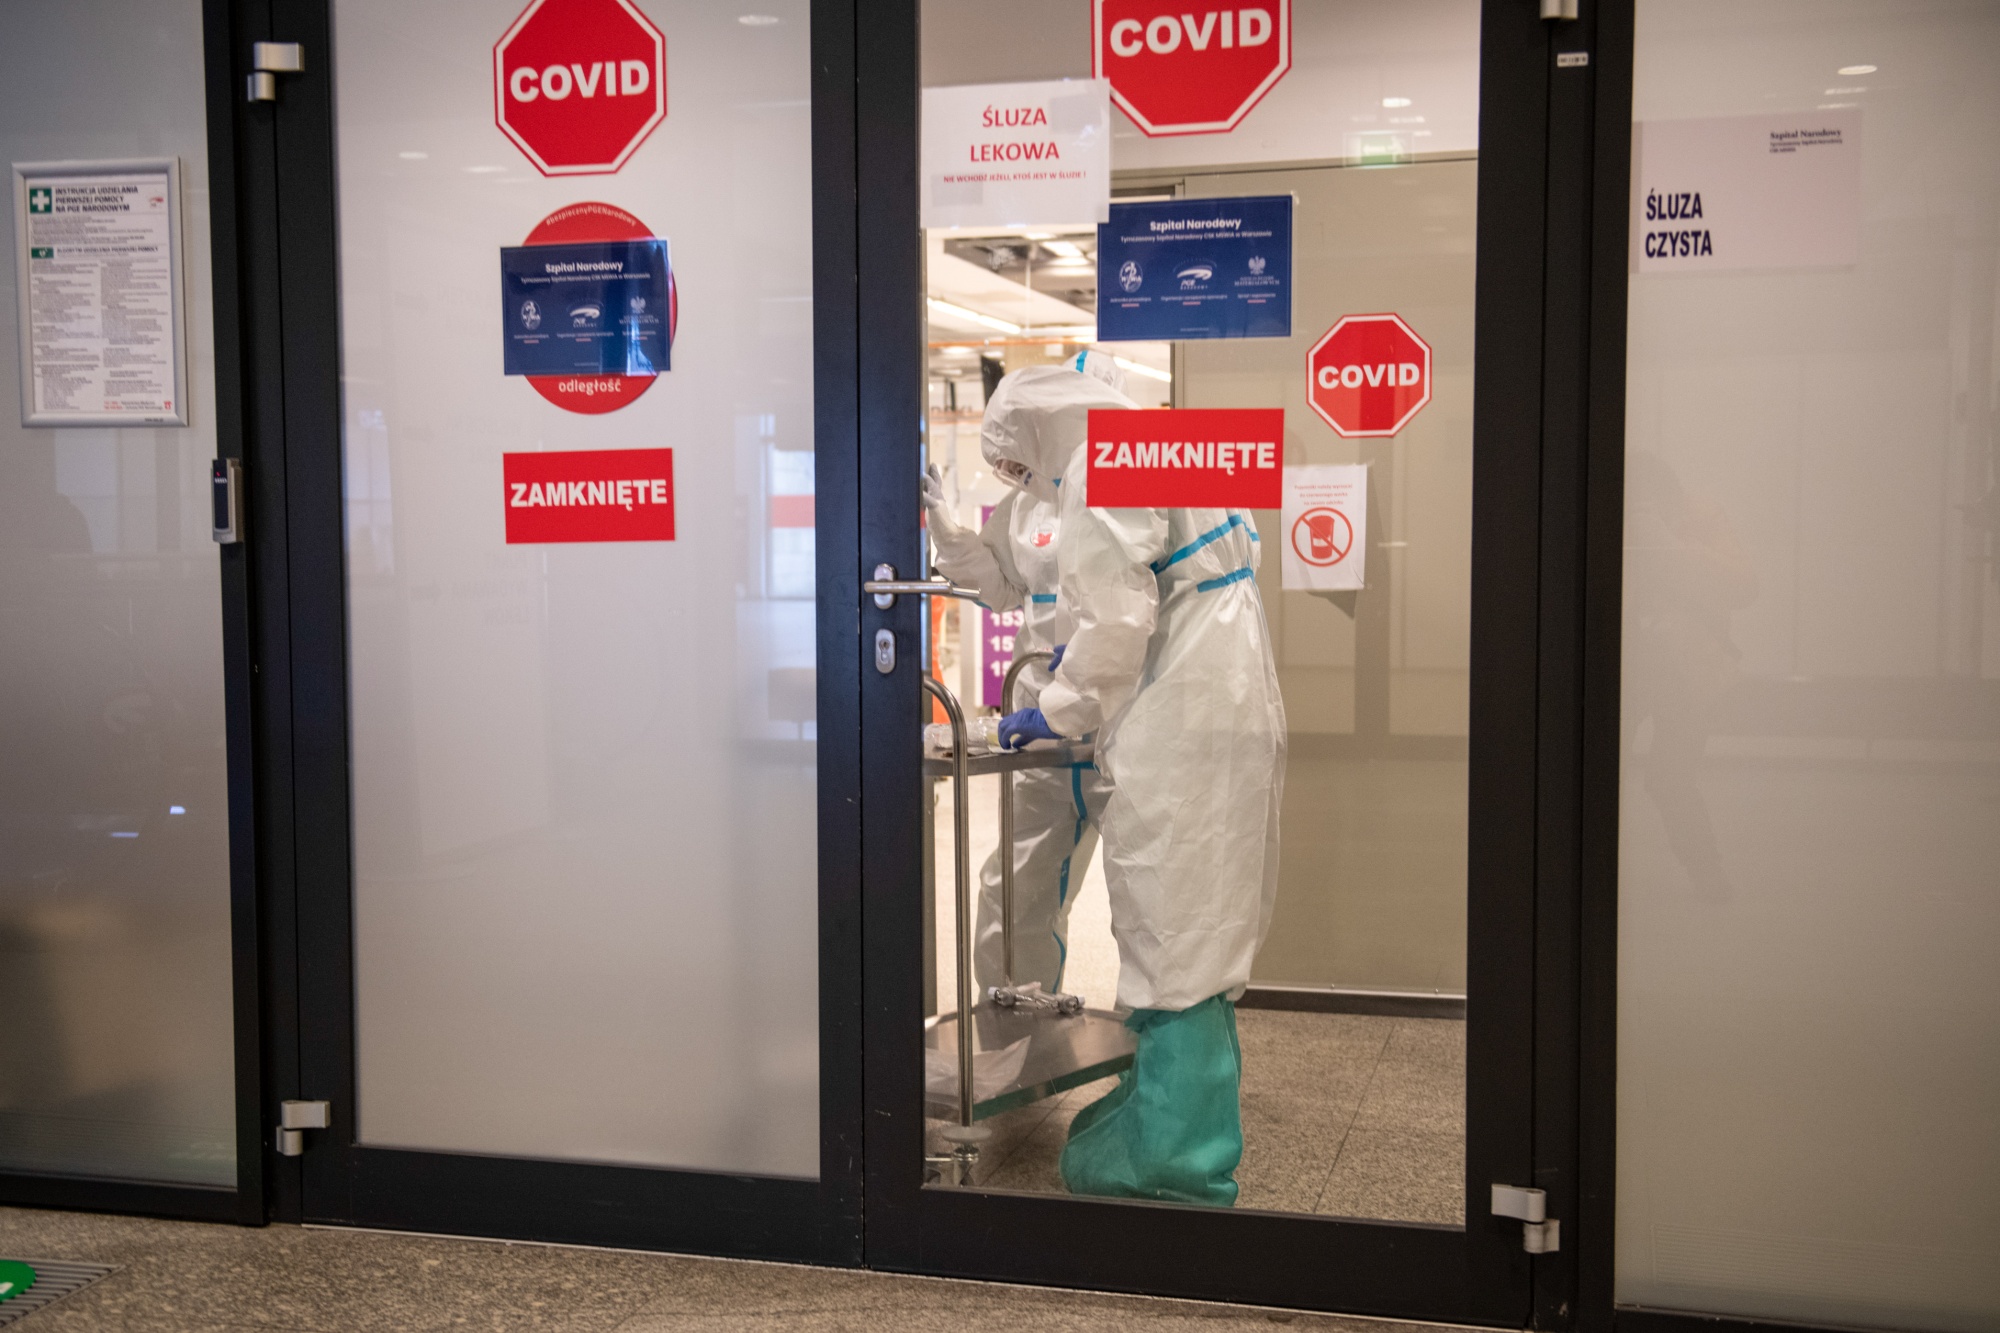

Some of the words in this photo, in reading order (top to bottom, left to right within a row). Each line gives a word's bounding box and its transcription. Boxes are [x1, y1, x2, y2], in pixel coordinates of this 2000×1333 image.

[1110, 8, 1272, 57] COVID
[510, 59, 650, 103] COVID
[982, 104, 1047, 128] ŚLUZA
[1800, 128, 1842, 139] Narodowy
[970, 142, 1060, 162] LEKOWA
[943, 174, 955, 183] NIE
[1013, 171, 1031, 181] KTOŚ
[1033, 172, 1047, 180] JEST
[1059, 170, 1082, 180] ŚLUZIE
[55, 187, 96, 195] INSTRUKCJA
[97, 186, 138, 194] UDZIELANIA
[55, 196, 93, 204] PIERWSZEJ
[55, 205, 66, 213] NA
[82, 204, 130, 212] NARODOWYM
[1646, 187, 1703, 221] ŚLUZA
[1150, 219, 1185, 233] Szpital
[1186, 217, 1242, 230] Narodowy
[1645, 230, 1713, 258] CZYSTA
[545, 262, 575, 275] Szpital
[576, 260, 623, 273] Narodowy
[1317, 362, 1420, 390] COVID
[558, 378, 622, 396] odległość
[1093, 441, 1276, 476] ZAMKNIĘTE
[510, 479, 668, 511] ZAMKNIĘTE
[990, 611, 1025, 628] 153
[990, 635, 1015, 652] 15
